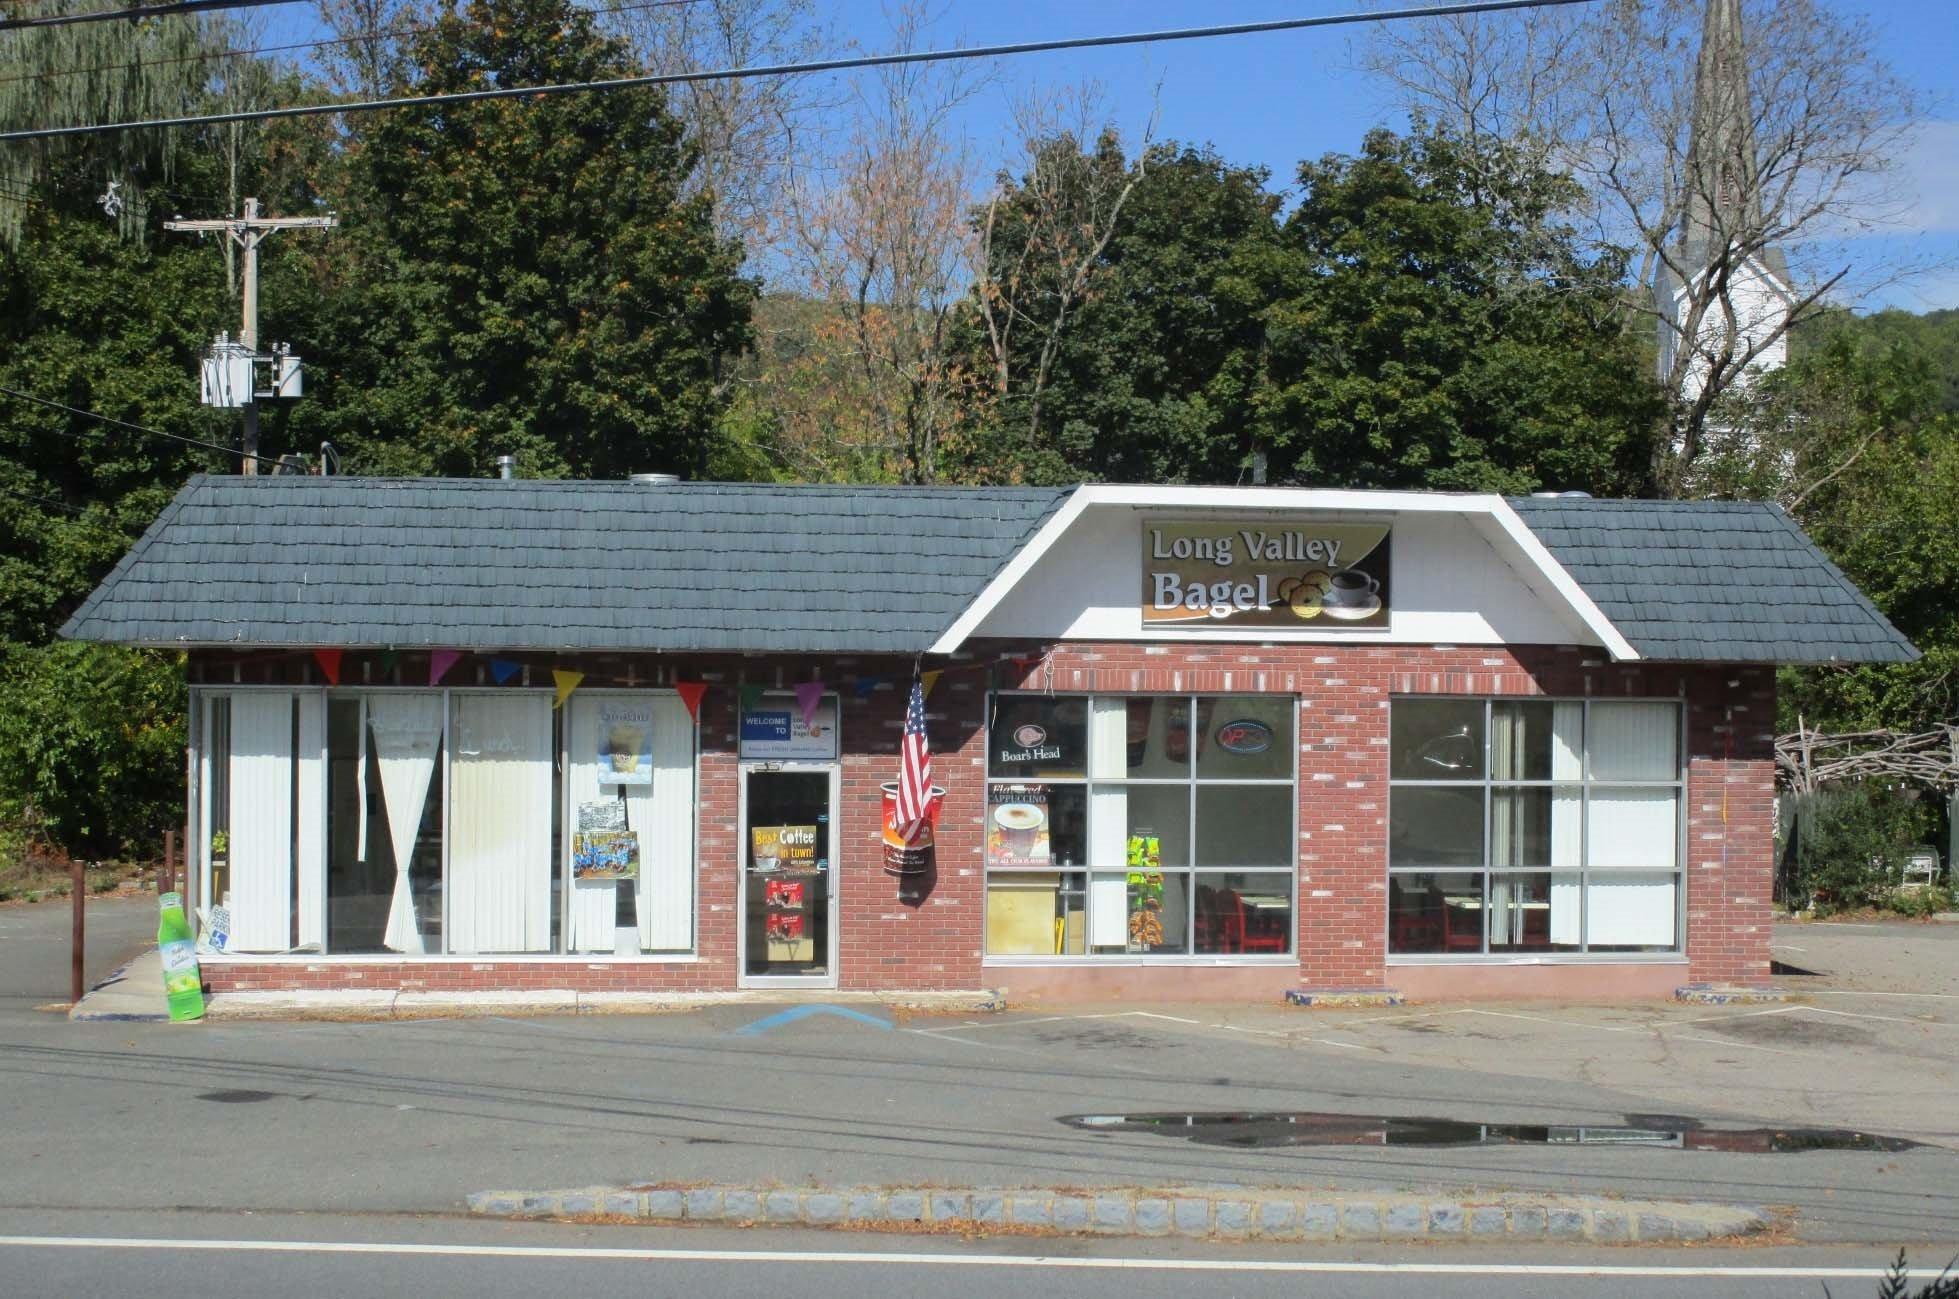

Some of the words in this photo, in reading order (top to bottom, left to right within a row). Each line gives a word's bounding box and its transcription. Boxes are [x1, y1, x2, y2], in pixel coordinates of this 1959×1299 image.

[1151, 529, 1233, 566] Long
[1239, 530, 1342, 567] Valley
[1151, 572, 1272, 618] Bagel
[745, 717, 787, 725] WELCOME
[775, 727, 787, 735] TO
[1001, 749, 1032, 762] Boar's
[1033, 745, 1061, 760] Head
[755, 830, 778, 845] Best
[780, 829, 814, 845] Coffee
[791, 846, 814, 858] town!
